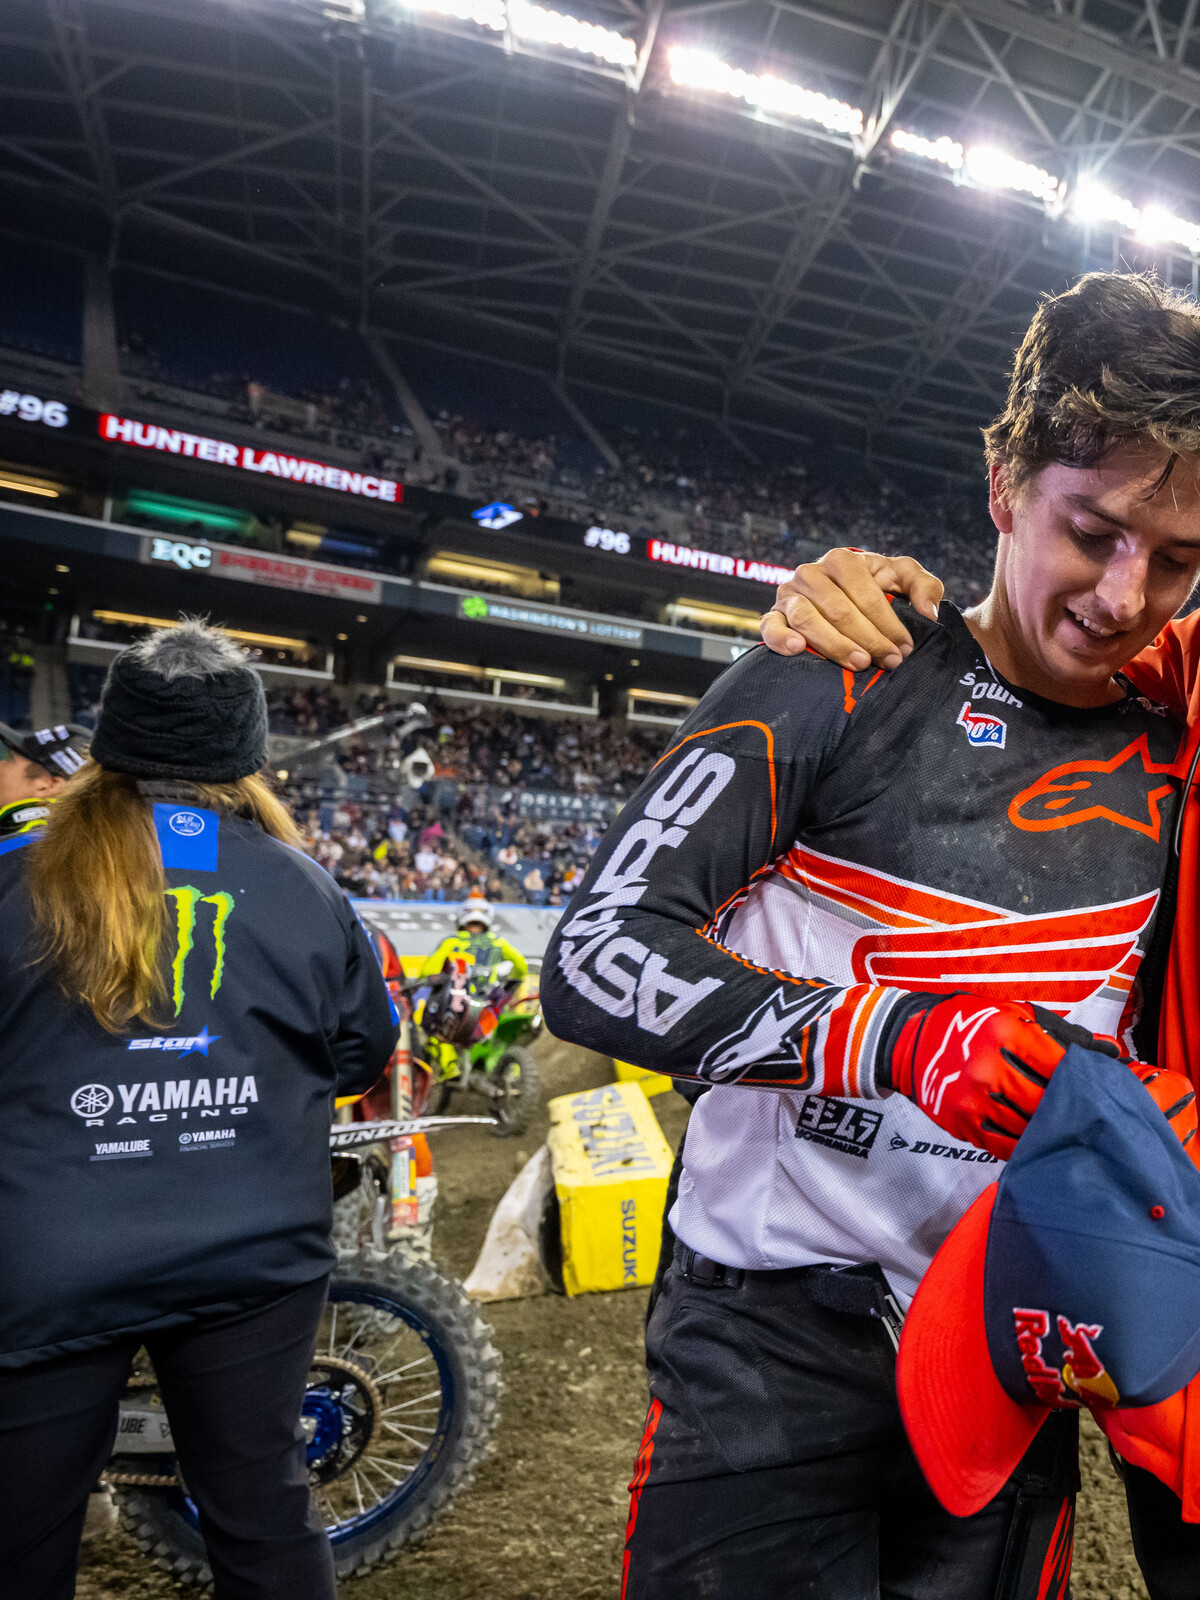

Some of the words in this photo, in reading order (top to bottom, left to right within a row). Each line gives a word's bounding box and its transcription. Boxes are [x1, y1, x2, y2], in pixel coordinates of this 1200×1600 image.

[0, 390, 69, 428] #96
[105, 416, 238, 467] HUNTER
[242, 448, 398, 502] LAWRENCE
[152, 538, 212, 570] EQC
[584, 526, 632, 555] #96
[651, 541, 735, 577] HUNTER
[736, 559, 796, 585] LAWR
[117, 1075, 259, 1113] YAMAHA
[86, 1106, 249, 1127] RACING
[192, 1129, 236, 1142] YAMAHA
[95, 1139, 151, 1155] YAMALUBE
[620, 1198, 638, 1288] SUZUKI
